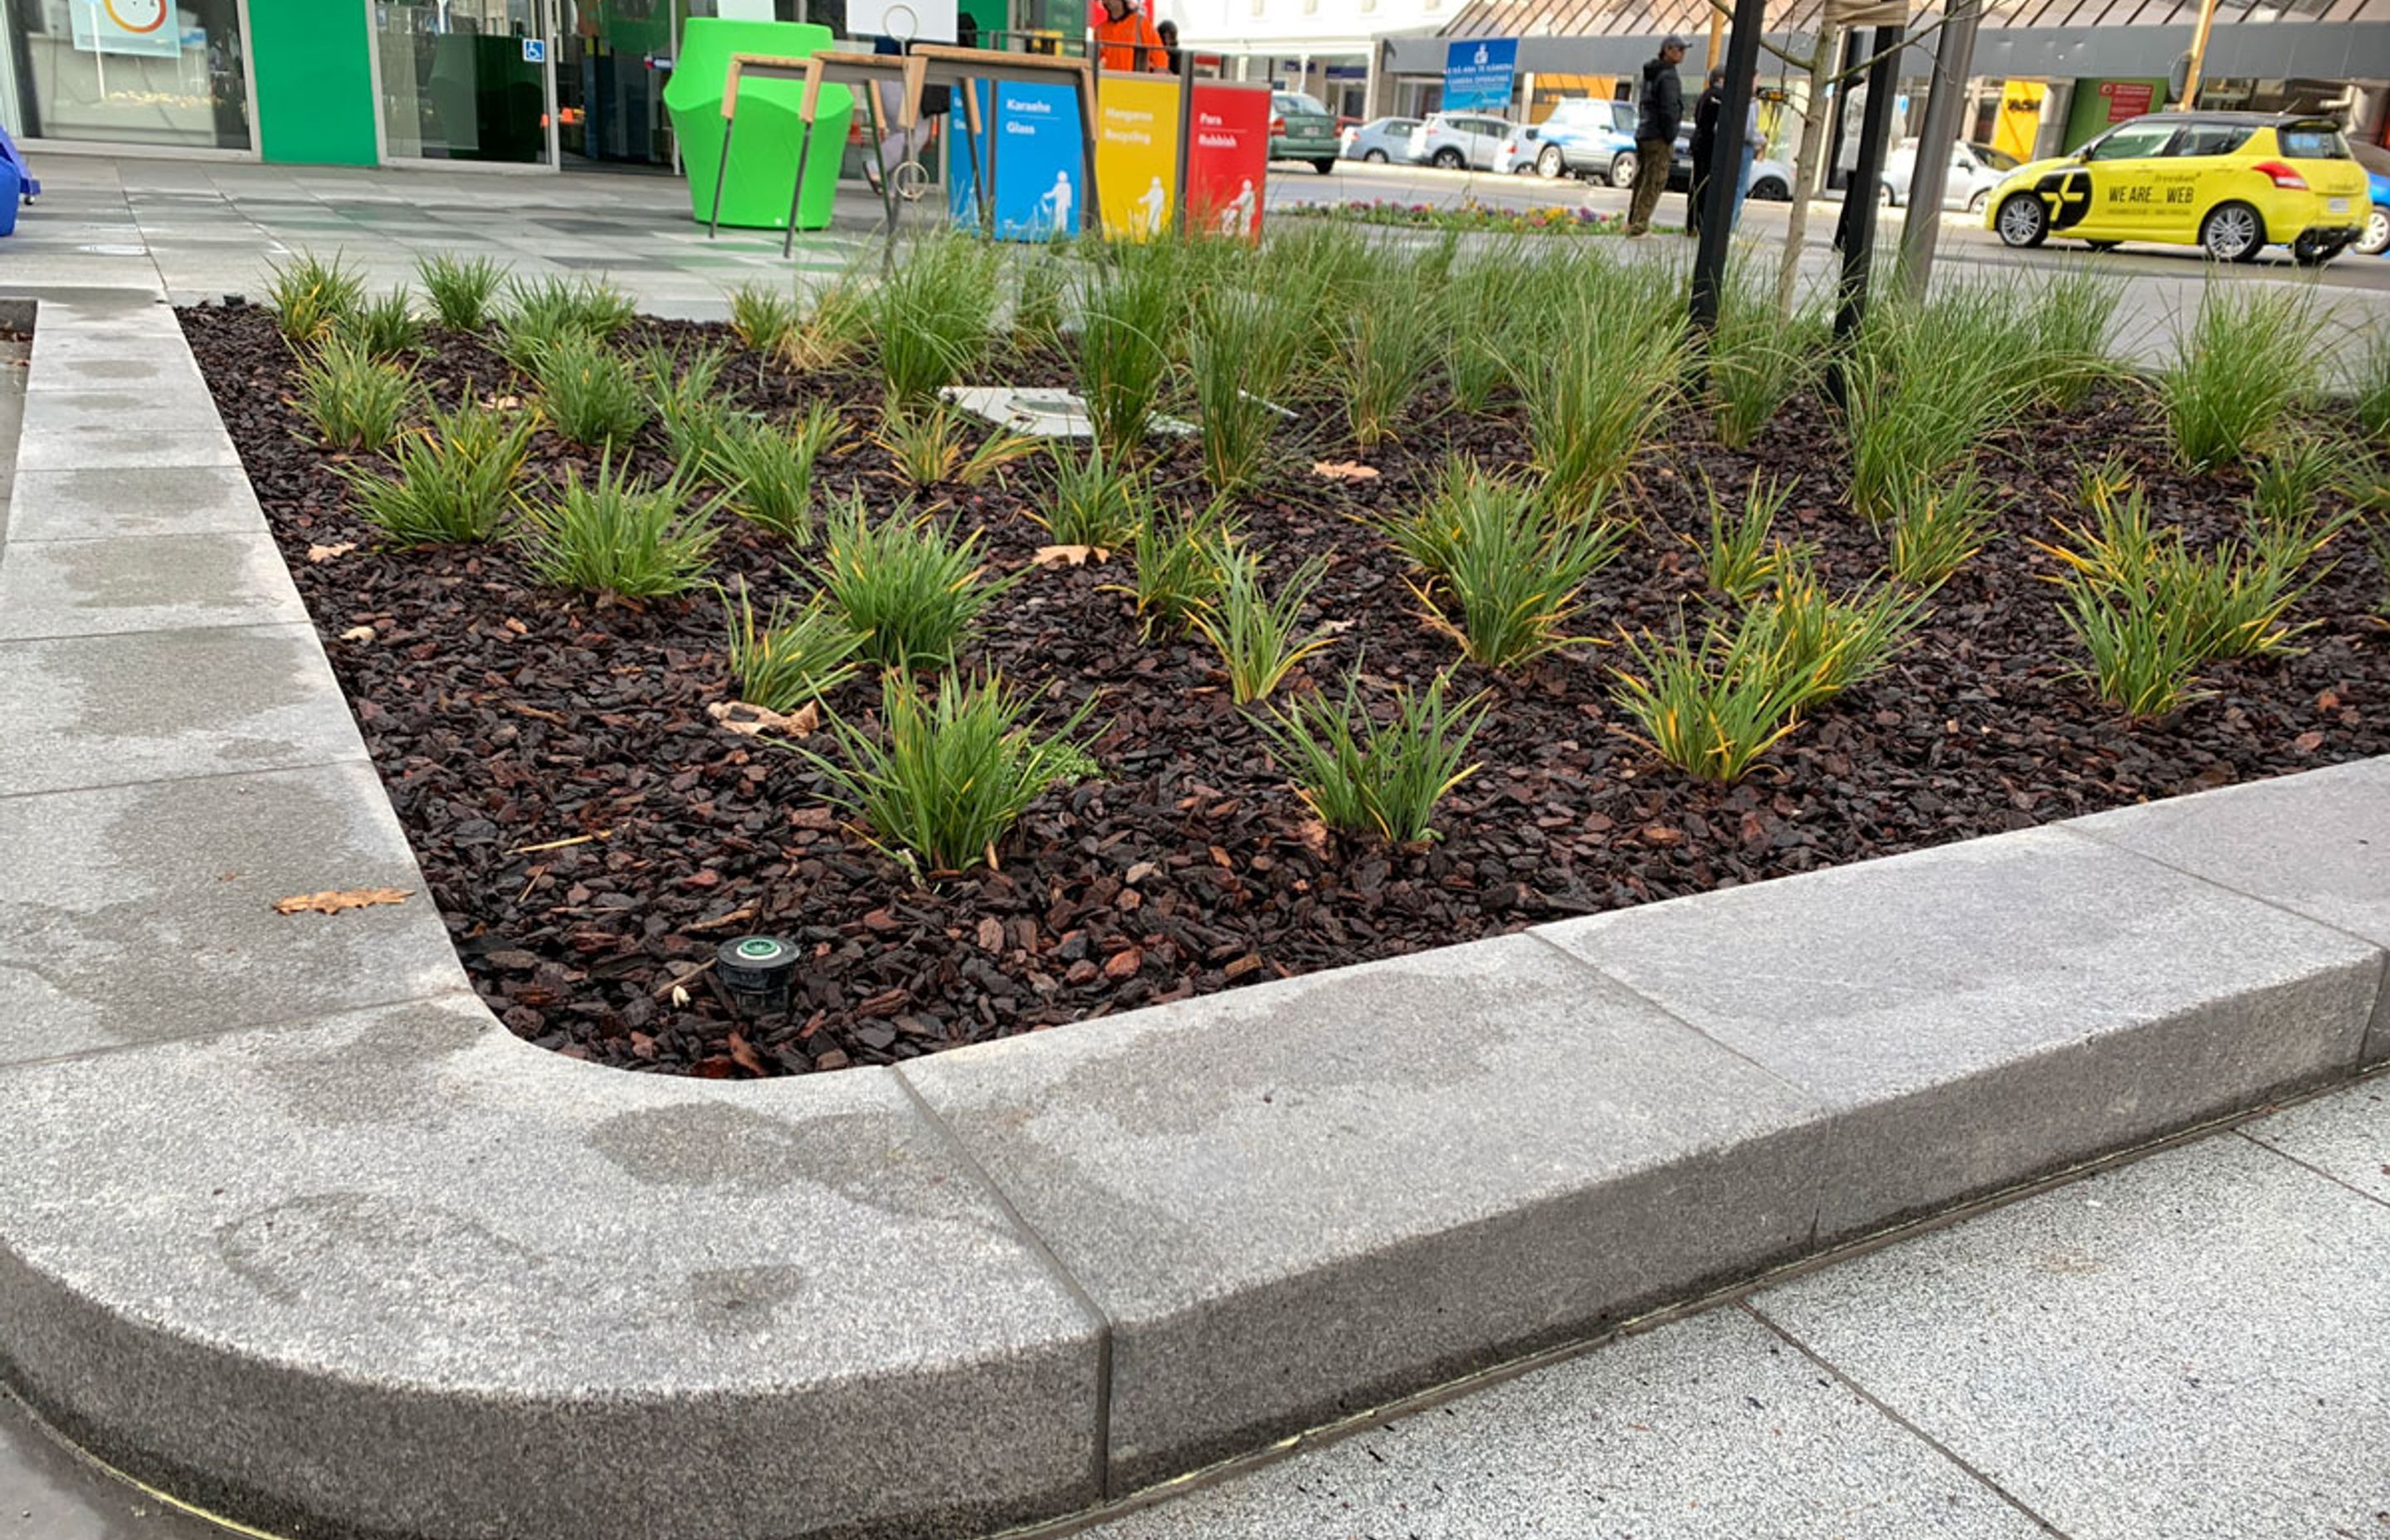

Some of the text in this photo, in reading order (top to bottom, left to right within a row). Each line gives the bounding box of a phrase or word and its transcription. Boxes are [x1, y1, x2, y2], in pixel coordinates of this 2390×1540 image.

[1006, 98, 1051, 114] Karaehe
[1199, 113, 1222, 125] Para
[1006, 121, 1036, 135] Glass
[1105, 129, 1151, 146] Recycling
[1197, 134, 1237, 148] Rubbish
[2109, 186, 2127, 202] WE
[2167, 187, 2195, 204] WEB
